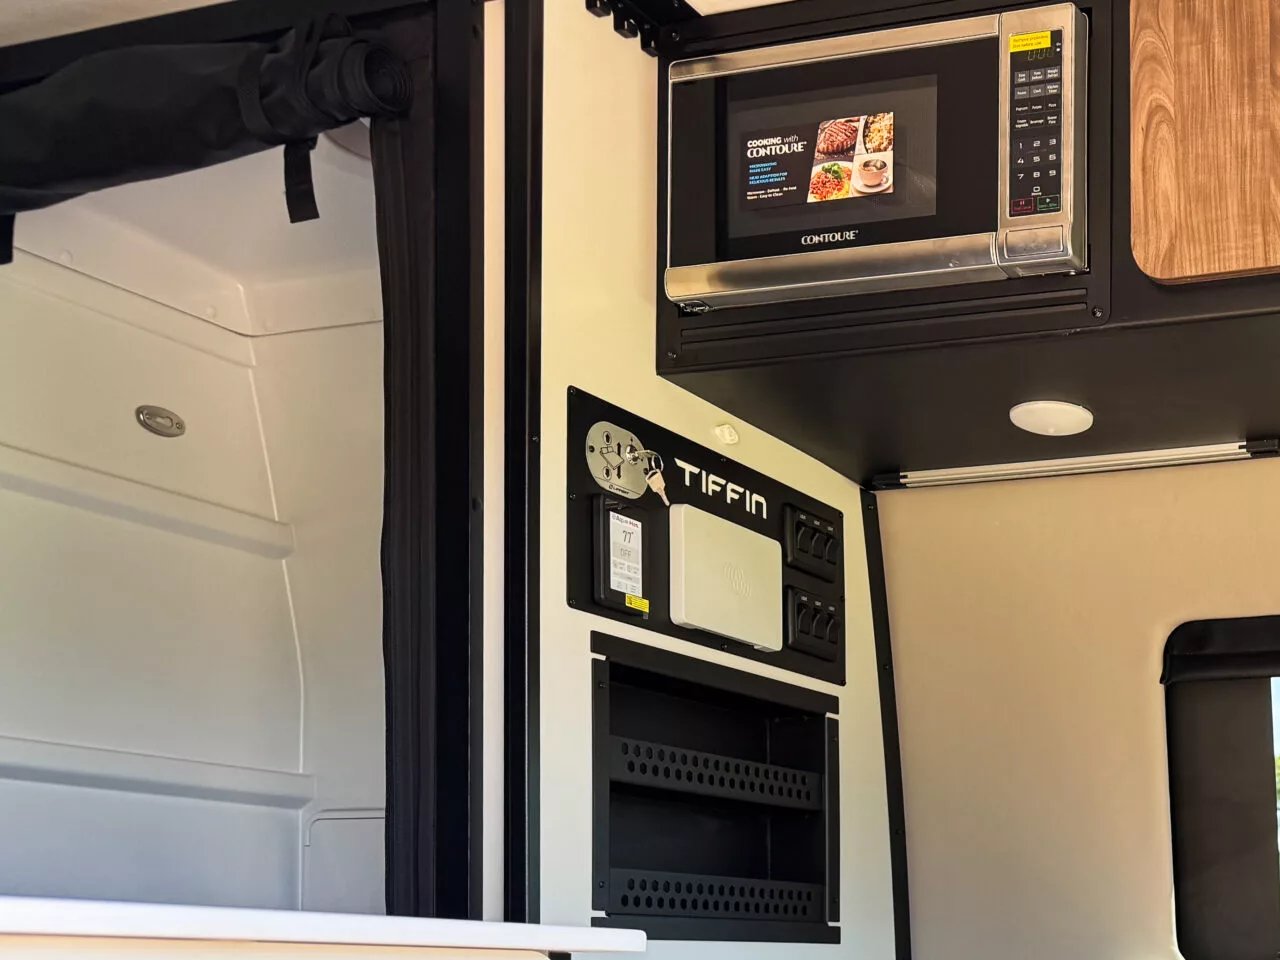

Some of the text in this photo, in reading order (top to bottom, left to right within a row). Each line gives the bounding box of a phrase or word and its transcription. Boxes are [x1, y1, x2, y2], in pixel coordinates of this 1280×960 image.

[747, 134, 799, 147] COOKING with
[747, 142, 805, 158] CONTOURE
[801, 230, 856, 245] CONTOURE
[674, 457, 767, 520] TIFFIN
